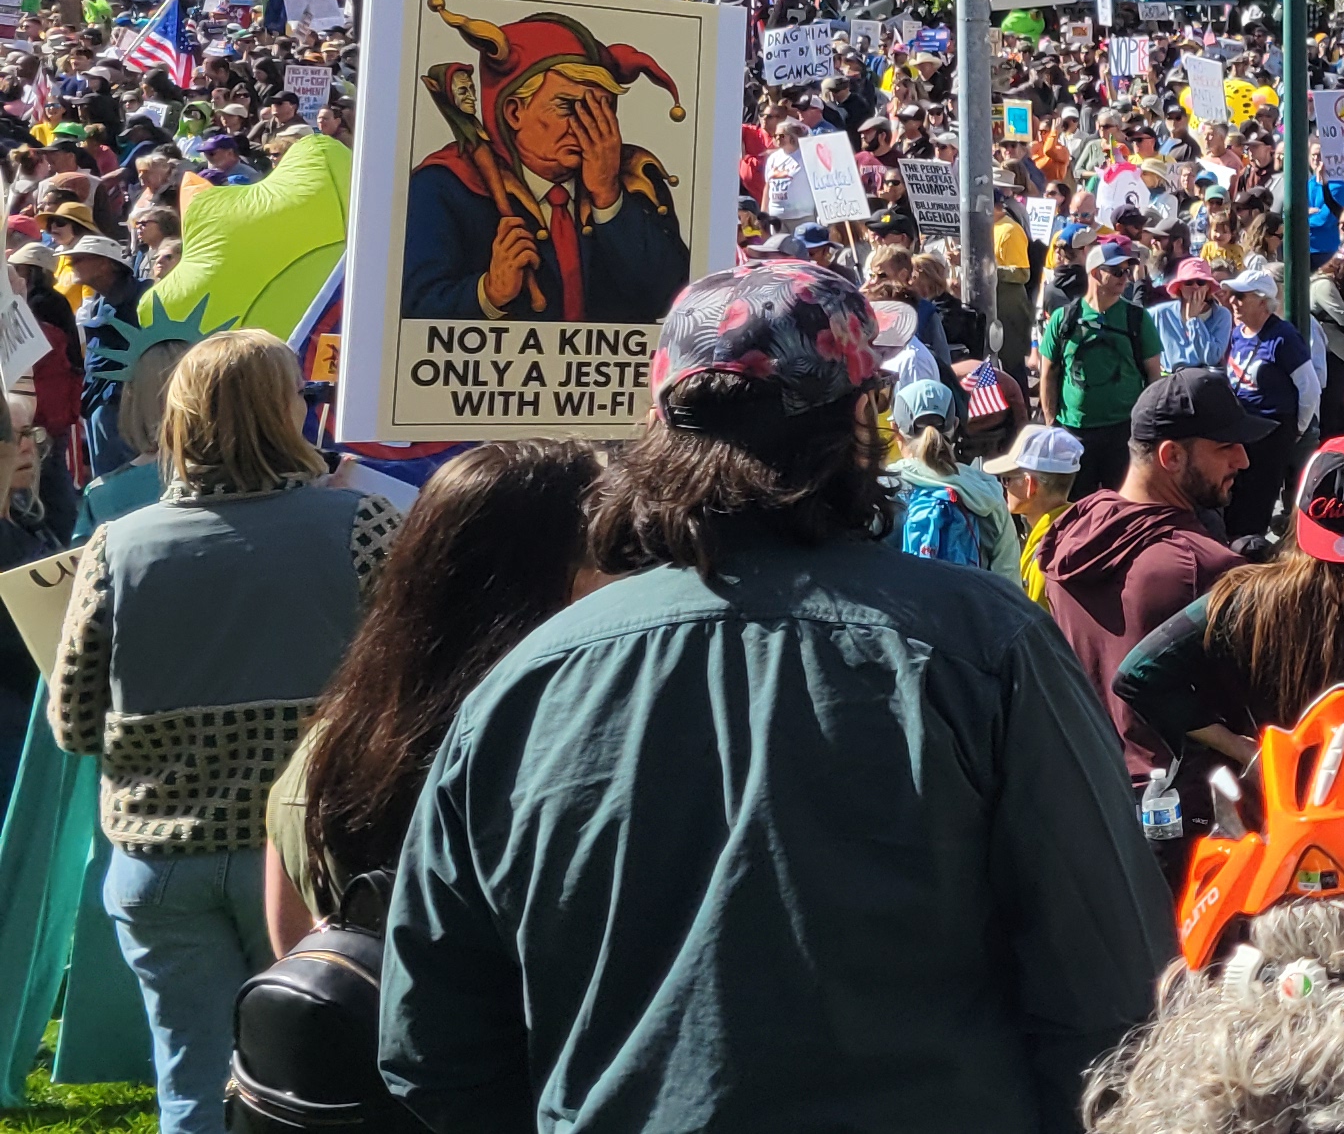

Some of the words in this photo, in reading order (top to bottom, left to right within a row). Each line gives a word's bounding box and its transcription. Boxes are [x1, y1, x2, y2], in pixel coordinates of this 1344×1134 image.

[767, 30, 798, 46] DRAG
[805, 27, 829, 40] HIM
[766, 49, 791, 60] OUT
[799, 46, 810, 57] BY
[816, 44, 832, 56] HIS
[1322, 125, 1337, 138] NO
[902, 163, 920, 173] THE
[921, 164, 950, 175] PEOPLE
[905, 173, 924, 183] WILL
[908, 182, 957, 196] TRUMP'S
[918, 211, 960, 223] AGENDA
[427, 326, 510, 355] NOT
[518, 327, 545, 355] A
[558, 328, 656, 361] KING,
[410, 359, 514, 387] ONLY
[521, 360, 547, 388] A
[451, 390, 541, 417] WITH
[553, 391, 635, 417] WI-FI
